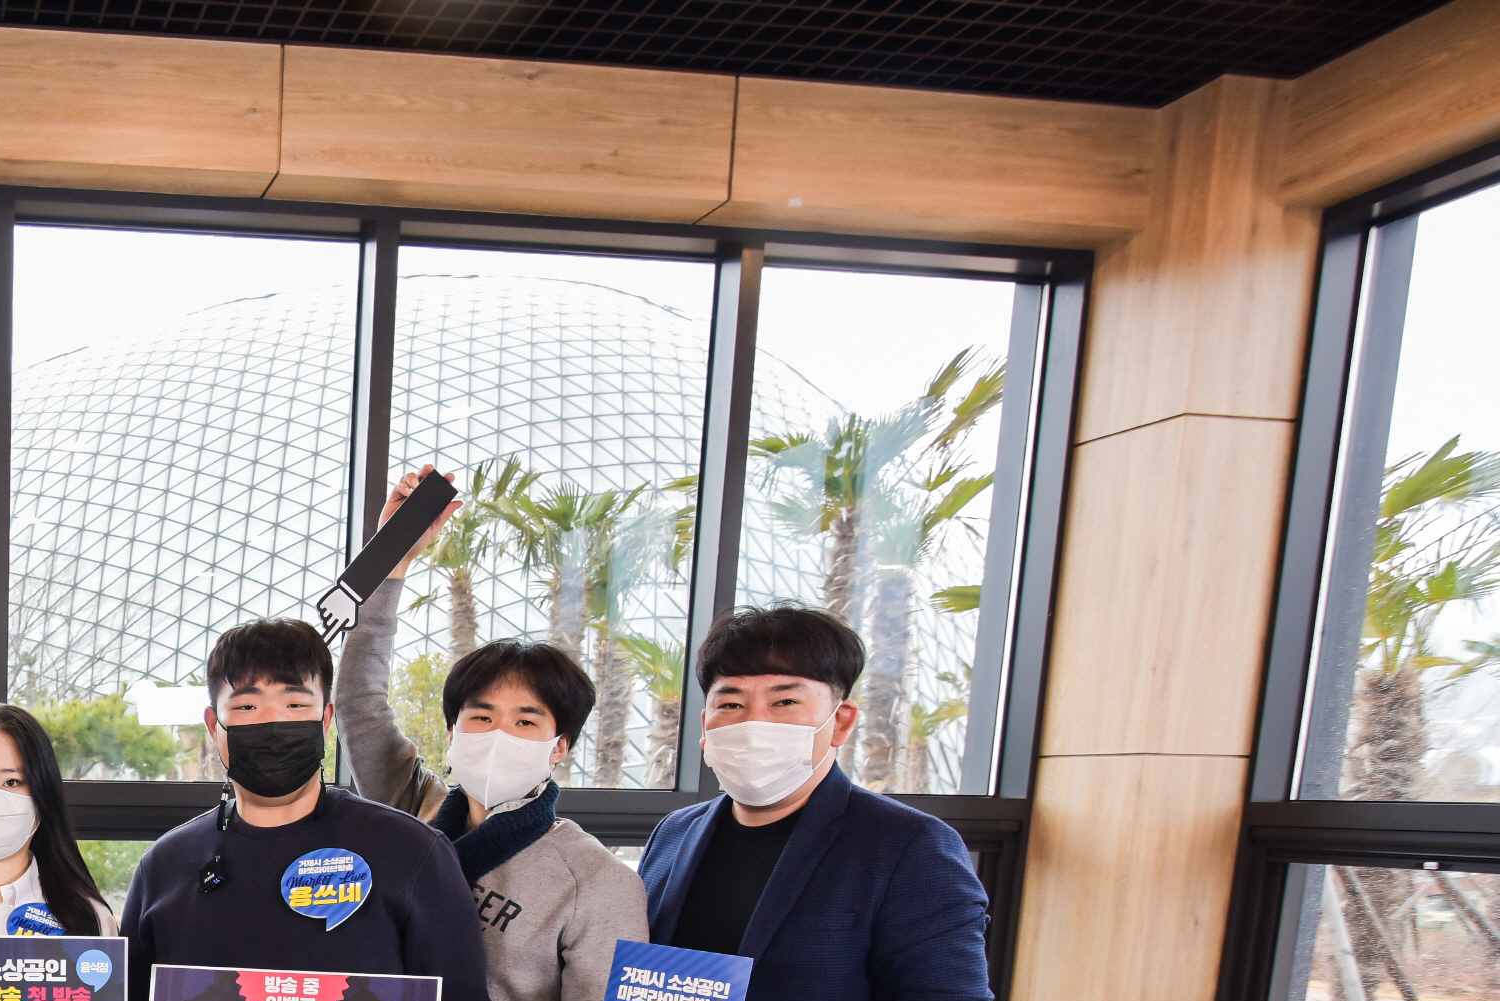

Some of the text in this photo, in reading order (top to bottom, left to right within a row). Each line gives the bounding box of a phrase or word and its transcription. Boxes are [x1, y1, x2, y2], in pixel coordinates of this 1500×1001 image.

[298, 864, 353, 875] 마켓라이브방송
[299, 856, 353, 867] 거제시 소상공인
[286, 870, 368, 889] Market Live
[289, 882, 362, 907] 용쓰네
[81, 961, 108, 974] 음식점
[264, 976, 319, 995] 방송 중
[620, 966, 731, 999] 거제시 소상공인
